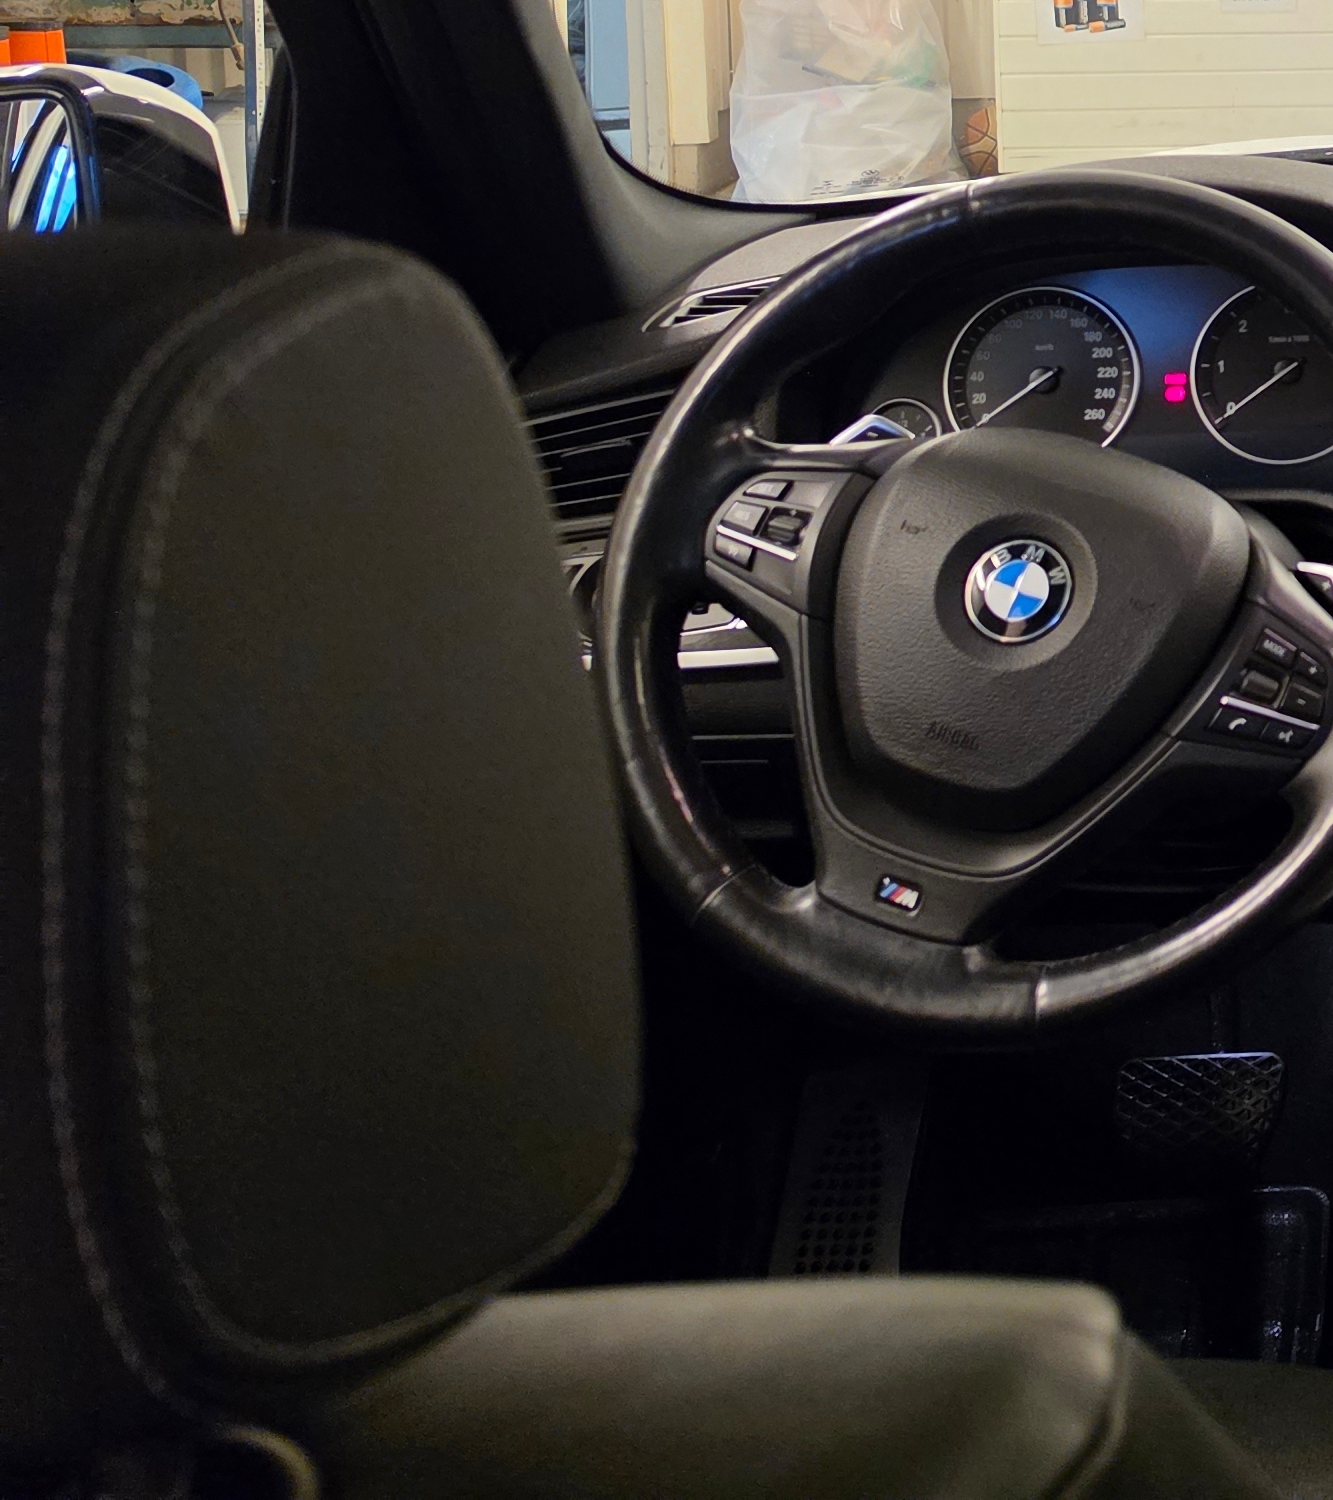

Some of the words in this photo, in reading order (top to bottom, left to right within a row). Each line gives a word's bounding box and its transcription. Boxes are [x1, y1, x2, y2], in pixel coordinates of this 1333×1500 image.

[1049, 309, 1068, 320] 140
[1070, 318, 1088, 328] 160
[1238, 319, 1248, 332] 2
[1084, 331, 1103, 342] 180
[1092, 347, 1113, 358] 200
[1217, 360, 1225, 373] 1
[970, 371, 985, 382] 40
[1097, 367, 1118, 378] 220
[972, 393, 987, 404] 20
[1094, 388, 1115, 399] 240
[1084, 409, 1105, 420] 260
[990, 545, 1067, 585] BMW
